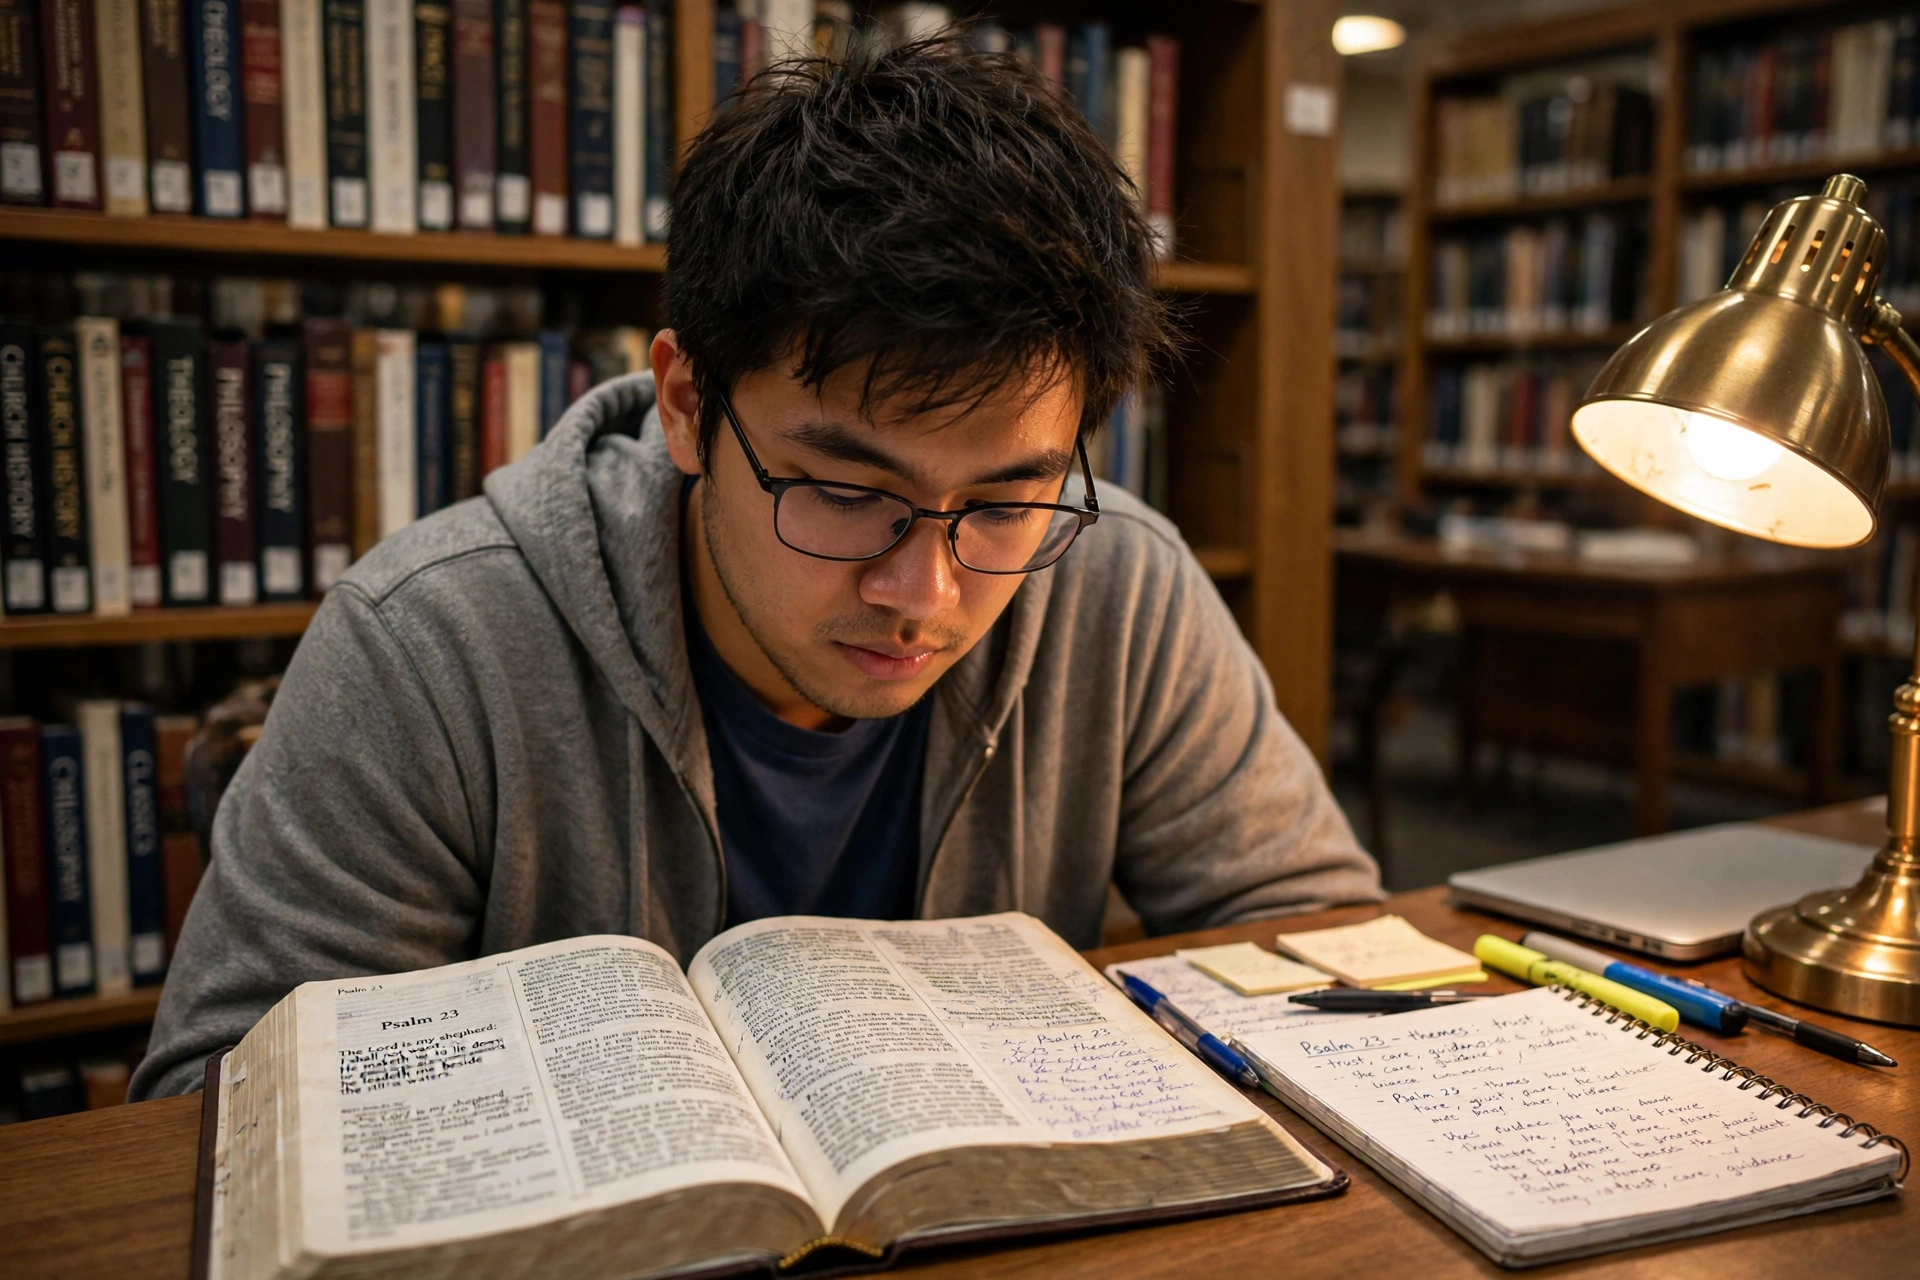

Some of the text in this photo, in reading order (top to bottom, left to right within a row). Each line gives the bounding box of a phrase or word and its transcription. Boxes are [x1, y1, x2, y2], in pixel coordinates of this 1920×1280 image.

[166, 356, 199, 485] THEOLOGY
[263, 362, 294, 513] PHILOSOPHY
[46, 356, 81, 540] CHURCH HISTORY
[216, 366, 248, 521] PHILOSOPHY
[5, 442, 35, 538] HISTORY
[368, 1042, 398, 1052] Lord
[416, 1036, 435, 1046] my
[439, 1023, 498, 1041] shepherd:
[381, 1009, 459, 1031] Psalm 23
[1037, 1028, 1111, 1045] Psalm 23
[1300, 1039, 1353, 1056] Psalm
[1360, 1035, 1385, 1048] 23
[1492, 1014, 1544, 1030] trust,
[1327, 1055, 1374, 1070] trust,
[1381, 1051, 1421, 1063] care,
[1392, 1092, 1434, 1104] Psalm
[1727, 1152, 1805, 1176] guidance
